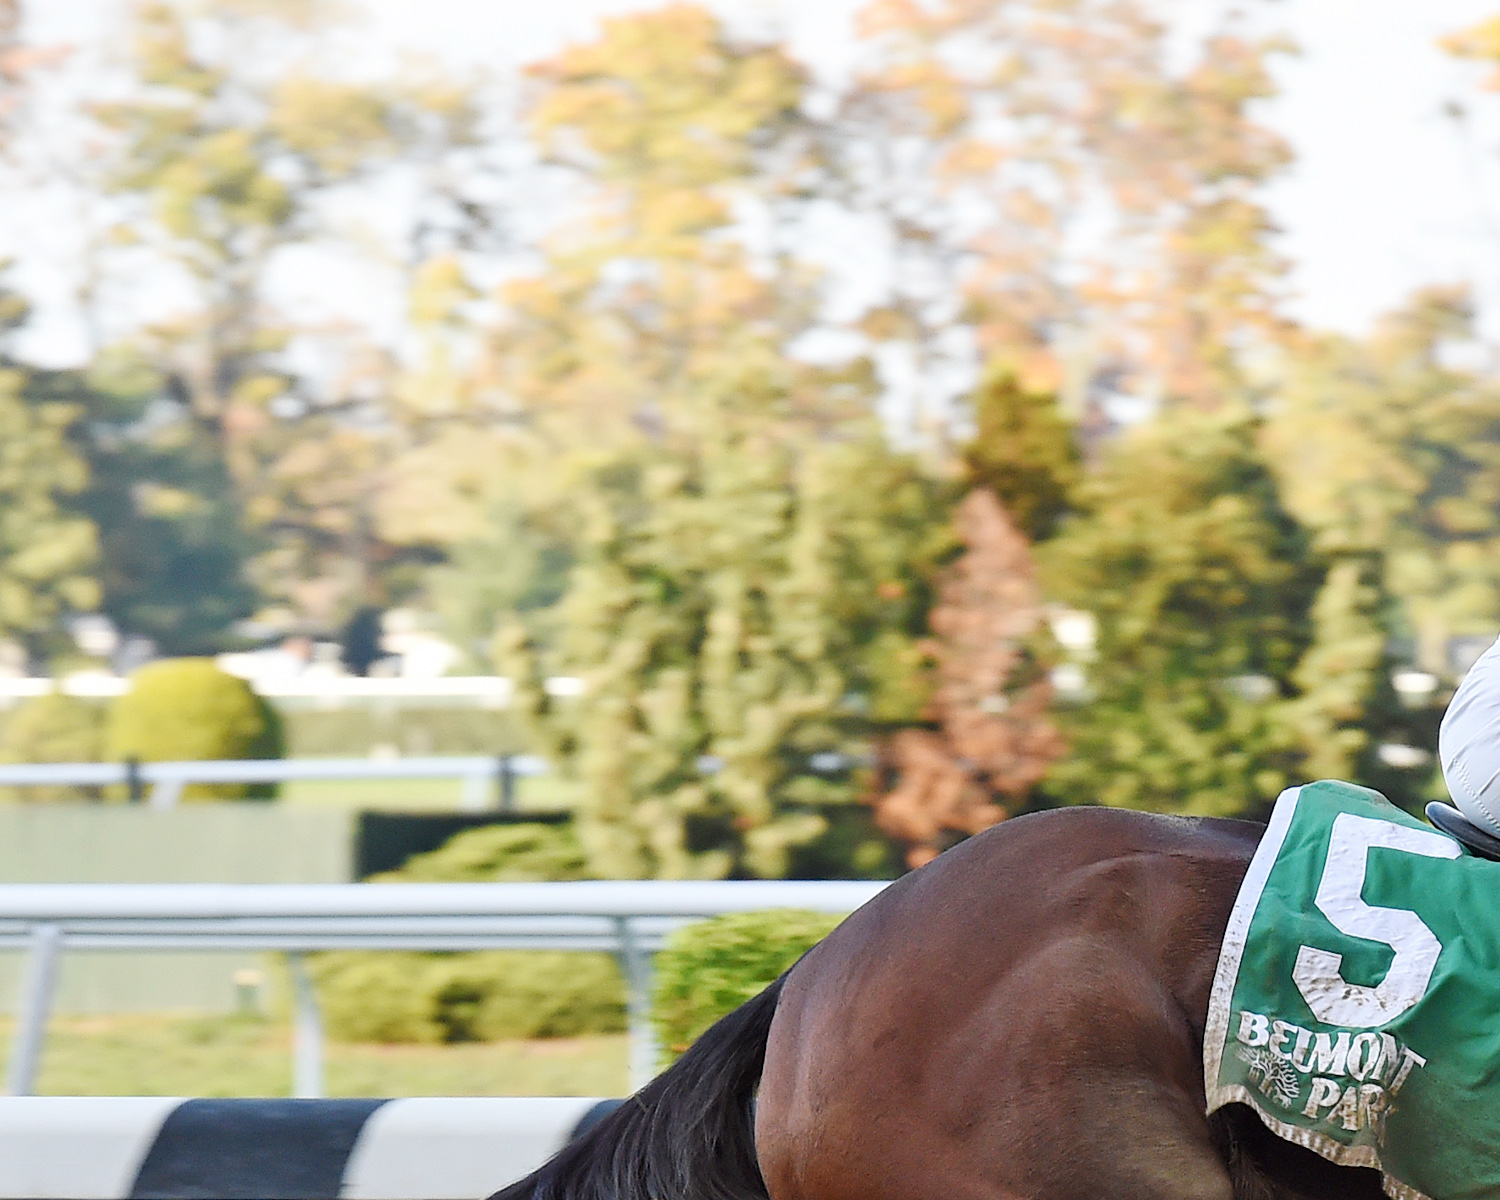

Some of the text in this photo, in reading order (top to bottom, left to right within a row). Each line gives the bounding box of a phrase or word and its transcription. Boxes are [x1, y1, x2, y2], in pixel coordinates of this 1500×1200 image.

[1292, 812, 1463, 1028] 5
[1236, 1010, 1427, 1097] BELMONT
[1301, 1077, 1399, 1142] PAR
